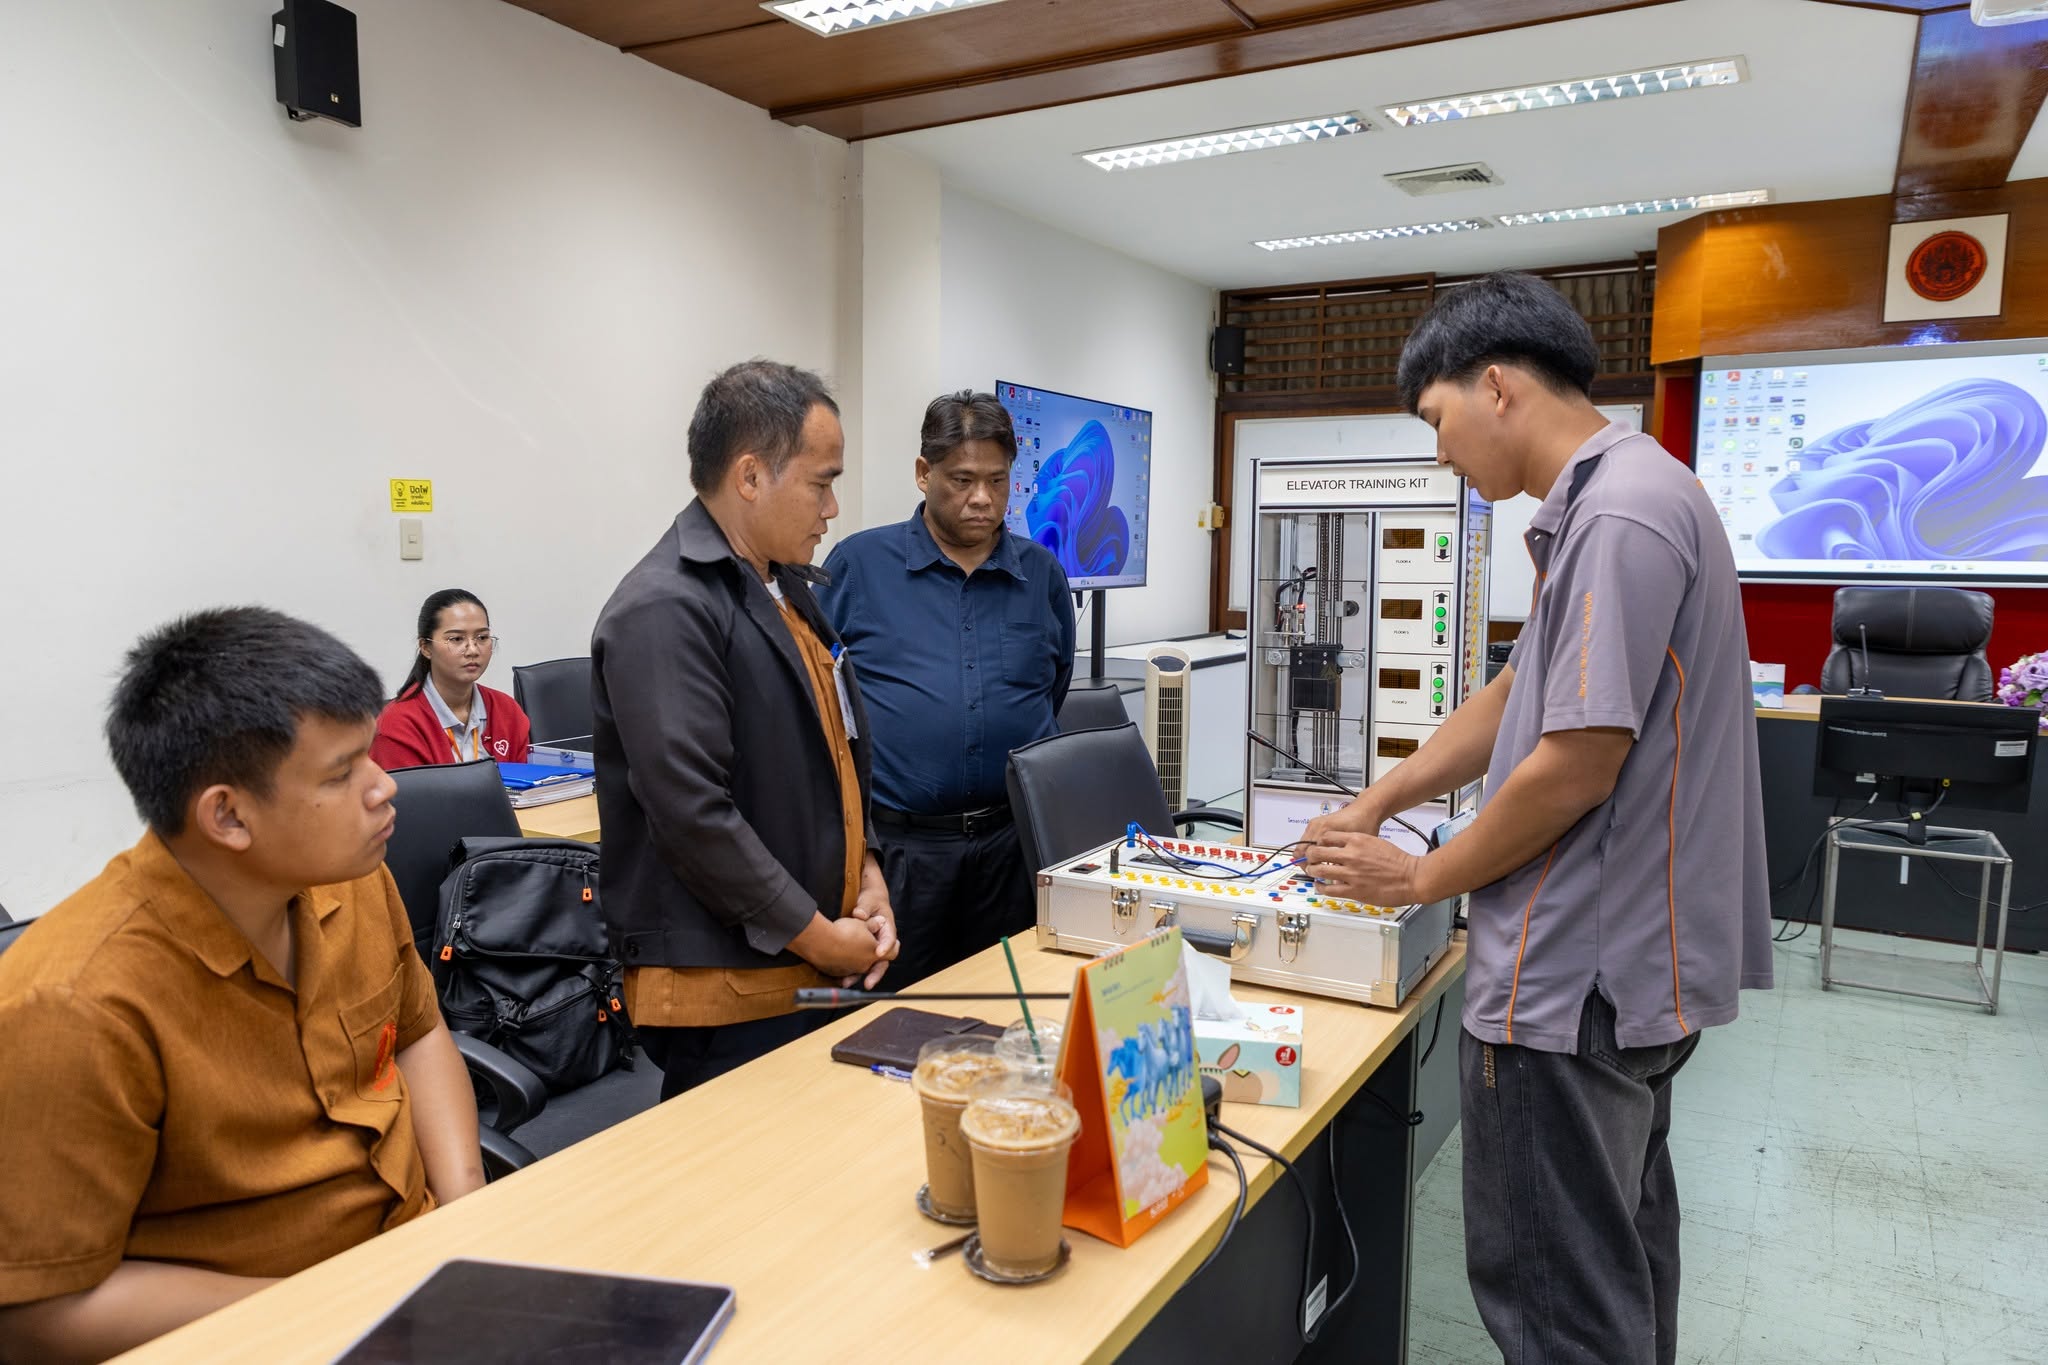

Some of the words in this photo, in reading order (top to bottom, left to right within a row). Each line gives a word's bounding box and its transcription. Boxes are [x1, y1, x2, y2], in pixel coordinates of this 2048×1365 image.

[1286, 479, 1346, 491] ELEVATOR
[1349, 478, 1406, 489] TRAINING
[1409, 477, 1429, 488] KIT
